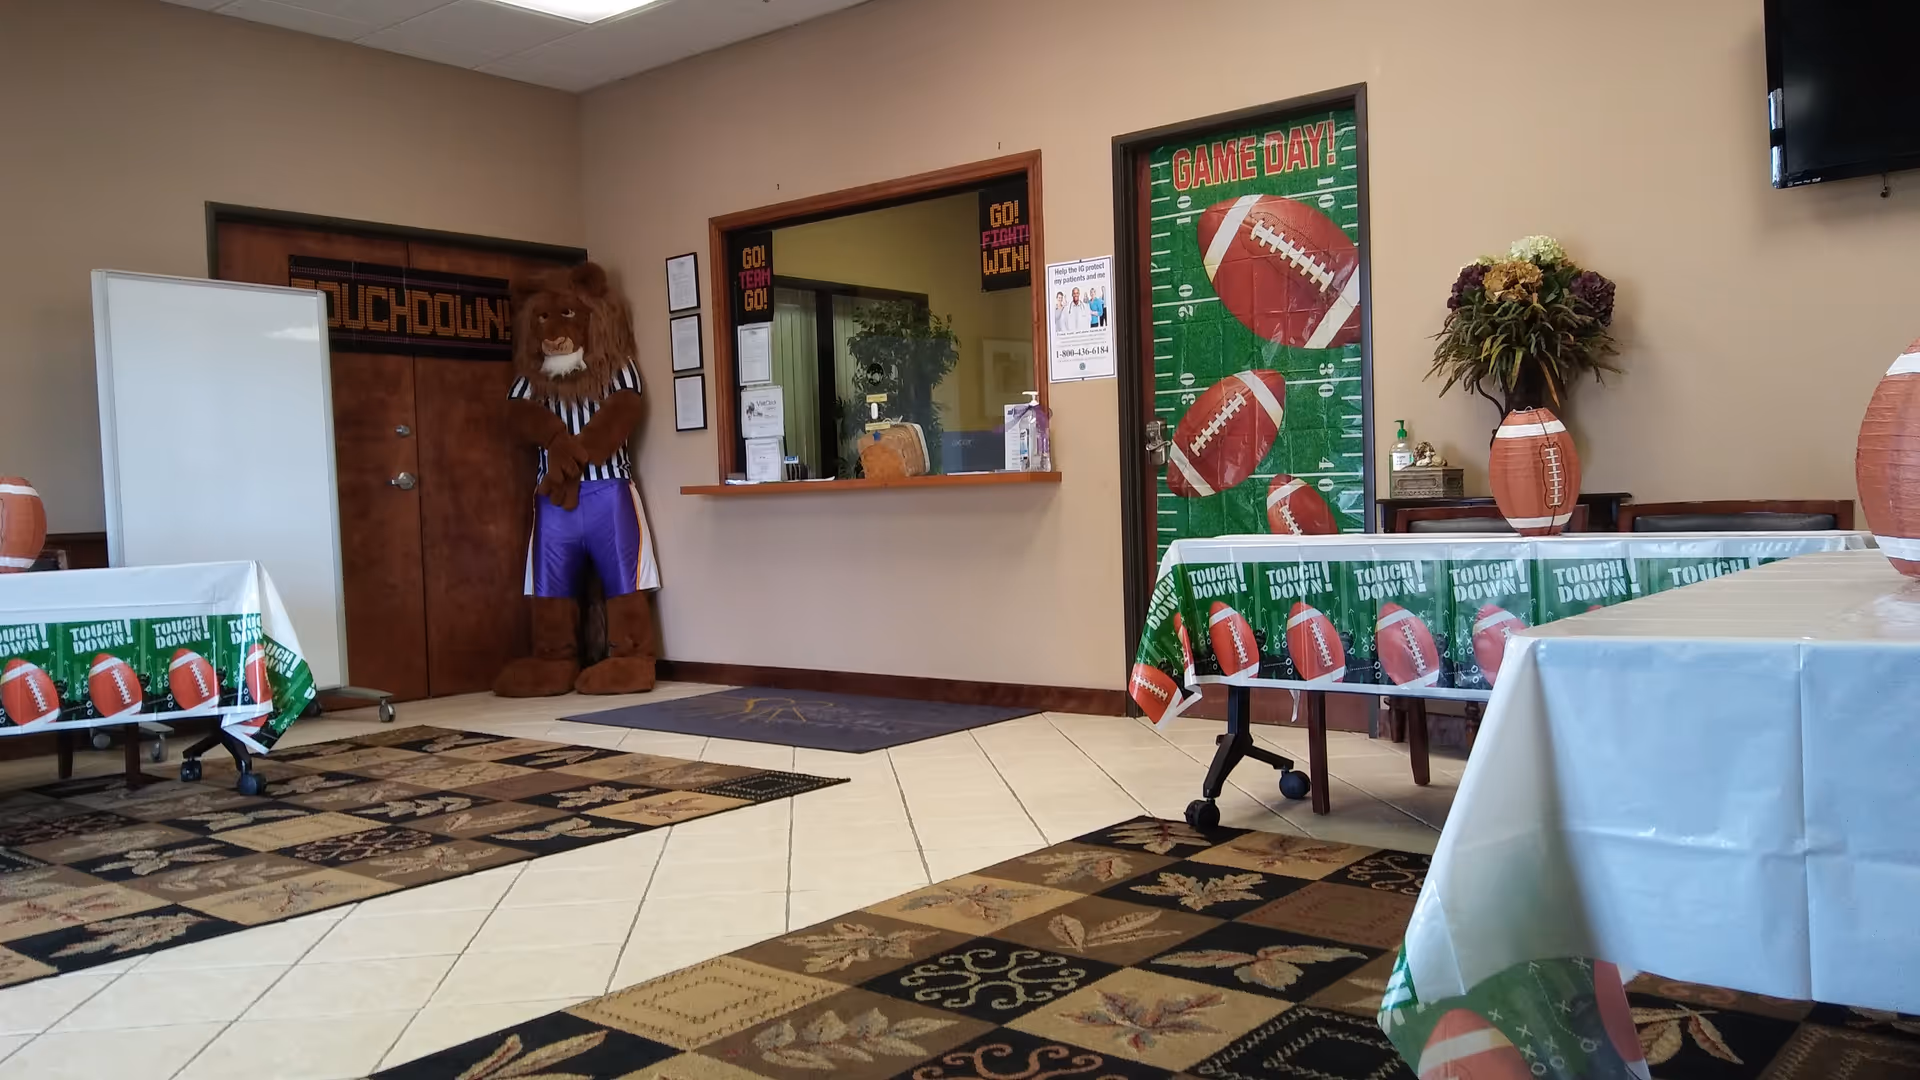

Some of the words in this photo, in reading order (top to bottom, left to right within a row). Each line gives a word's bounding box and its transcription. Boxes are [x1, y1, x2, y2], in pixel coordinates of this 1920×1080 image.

[1172, 136, 1258, 191] GAME
[1264, 119, 1336, 177] DAY!
[1316, 175, 1335, 209] 10
[989, 199, 1019, 228] GO!
[1176, 195, 1192, 226] 10
[982, 224, 1030, 249] FIGHT!
[742, 245, 766, 269] GO!
[982, 244, 1030, 275] WIN!
[1054, 268, 1068, 276] Help
[1068, 266, 1078, 274] the
[1085, 262, 1105, 272] protect
[738, 267, 771, 290] TEAM
[1063, 275, 1086, 285] patients
[1086, 272, 1097, 280] and
[290, 277, 512, 341] OUCHDOWN!
[744, 288, 768, 311] GO!
[1178, 283, 1194, 318] 20
[1056, 345, 1109, 359] 1-800-436-6184
[1179, 372, 1196, 406] 30
[1318, 362, 1335, 398] 30
[1317, 456, 1335, 492] 40
[1188, 564, 1236, 586] TOUCH
[1265, 563, 1321, 586] TOUCH
[1354, 562, 1413, 585] TOUCH
[1449, 560, 1514, 585] TOUCH
[1553, 559, 1623, 586] TOUCH
[1148, 572, 1175, 613] OUCH
[69, 622, 124, 641] TOUCH
[152, 616, 201, 637] TOUCH
